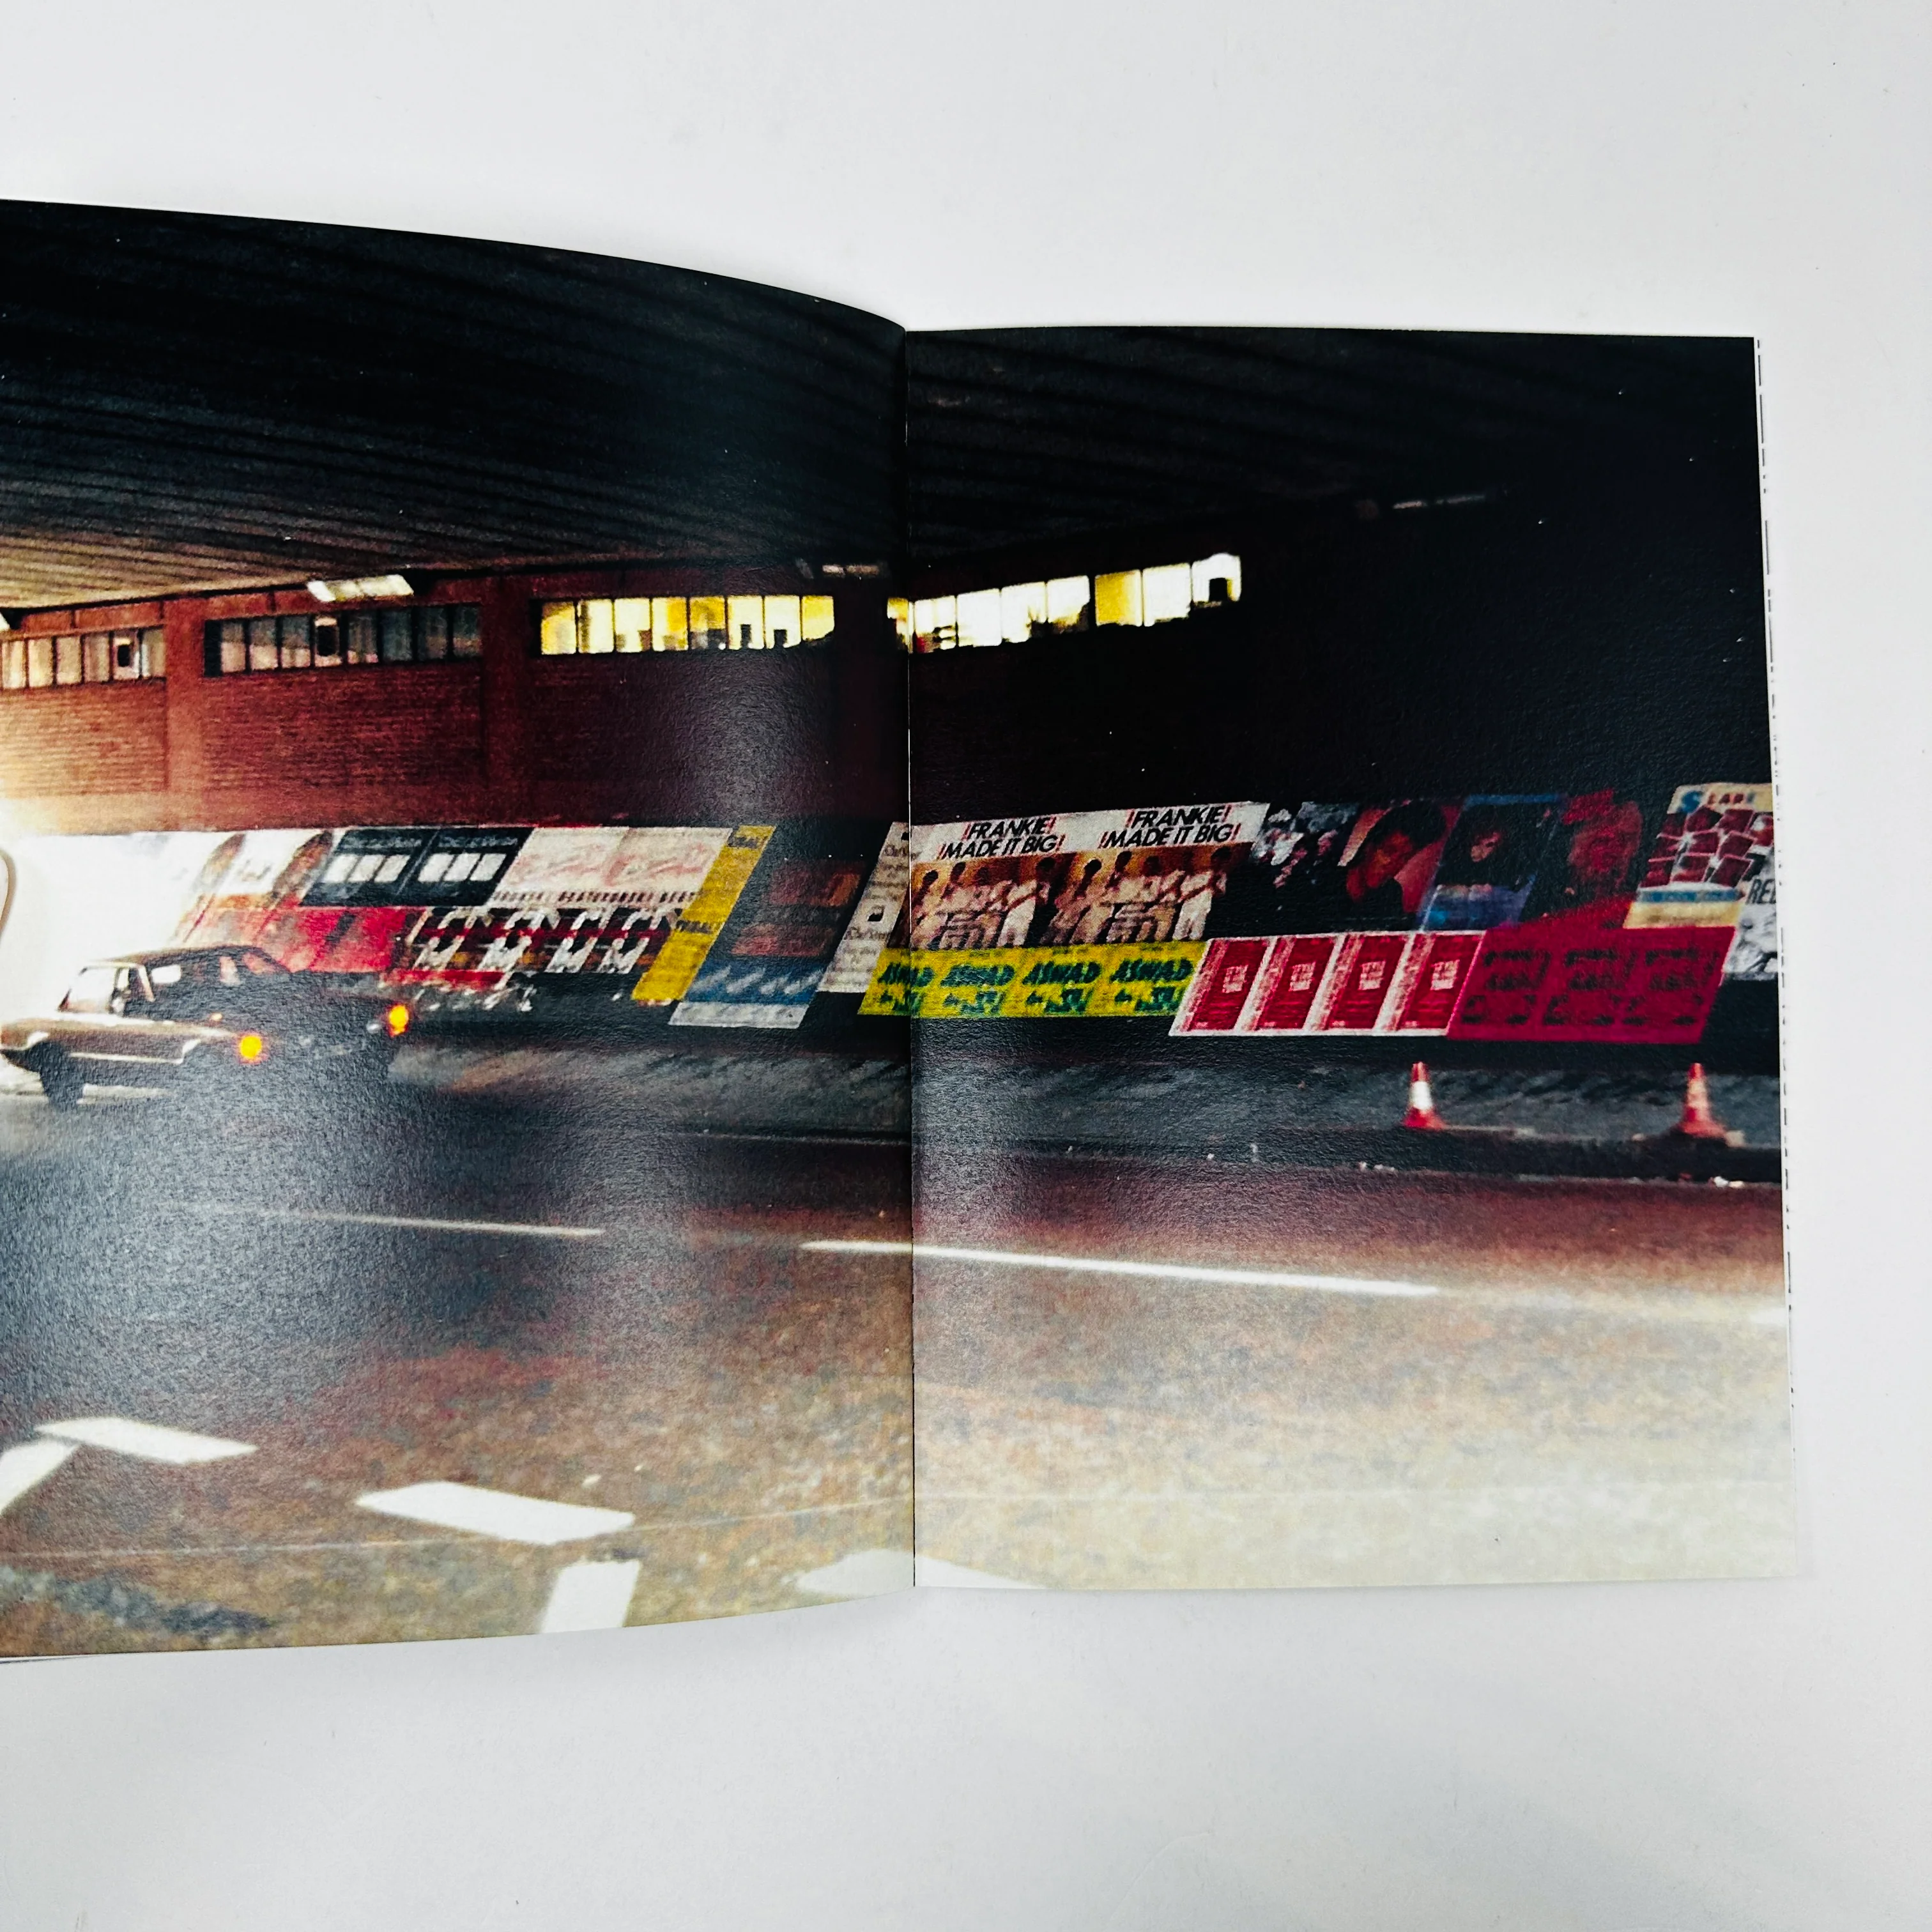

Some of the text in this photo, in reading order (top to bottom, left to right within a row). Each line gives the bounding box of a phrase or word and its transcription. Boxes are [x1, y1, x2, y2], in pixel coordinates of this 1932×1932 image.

[1002, 838, 1022, 856] IT
[1020, 834, 1066, 854] BIG!
[1173, 825, 1194, 845] IT
[1193, 823, 1241, 843] BIG!
